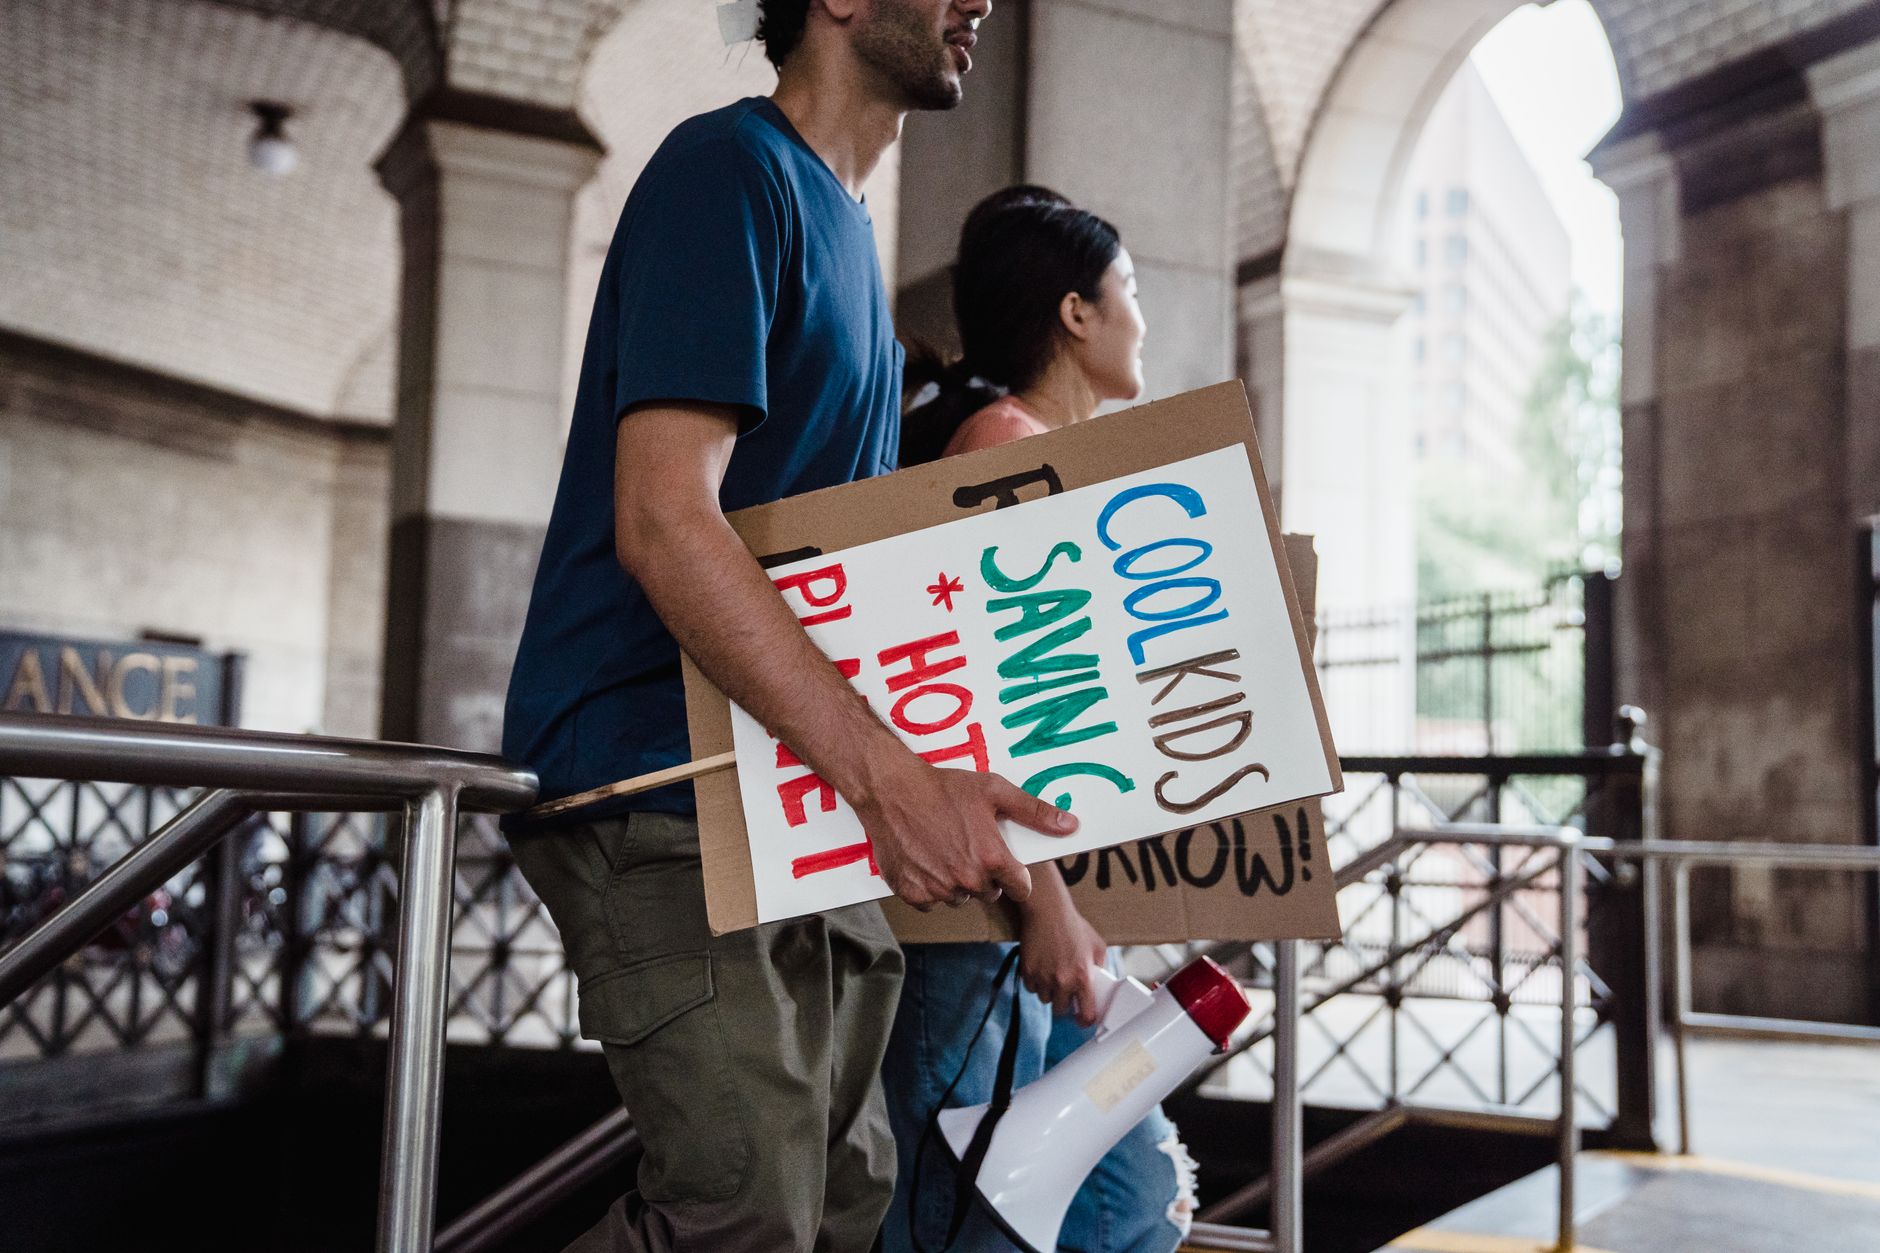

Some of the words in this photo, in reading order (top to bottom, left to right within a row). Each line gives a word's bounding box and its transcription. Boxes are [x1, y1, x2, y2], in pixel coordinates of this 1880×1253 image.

[1097, 483, 1229, 665] COOL
[5, 647, 198, 724] ANCE
[766, 563, 884, 880] PLET
[877, 630, 989, 772] HOT
[980, 541, 1136, 808] SAVING
[1136, 648, 1269, 815] KIDS
